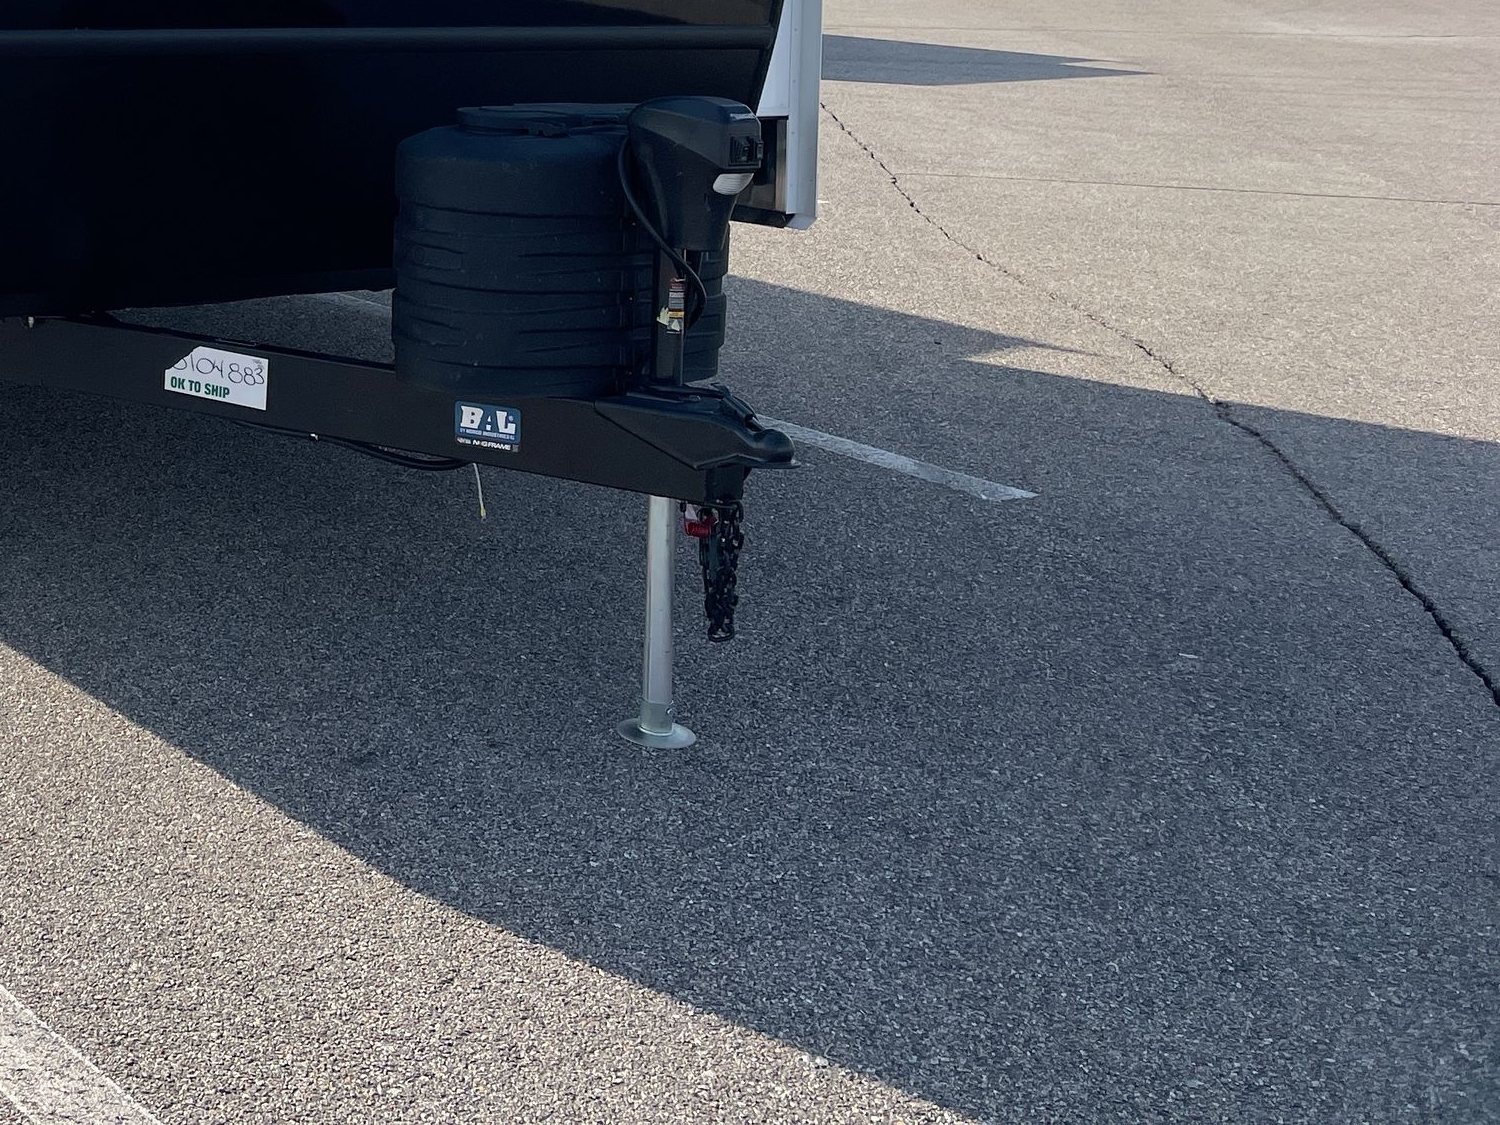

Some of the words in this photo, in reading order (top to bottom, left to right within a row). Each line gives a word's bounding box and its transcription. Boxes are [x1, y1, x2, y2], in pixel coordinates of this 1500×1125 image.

[170, 376, 186, 390] OK
[188, 379, 201, 393] TO
[204, 383, 230, 398] SHIP
[460, 405, 516, 435] BAL
